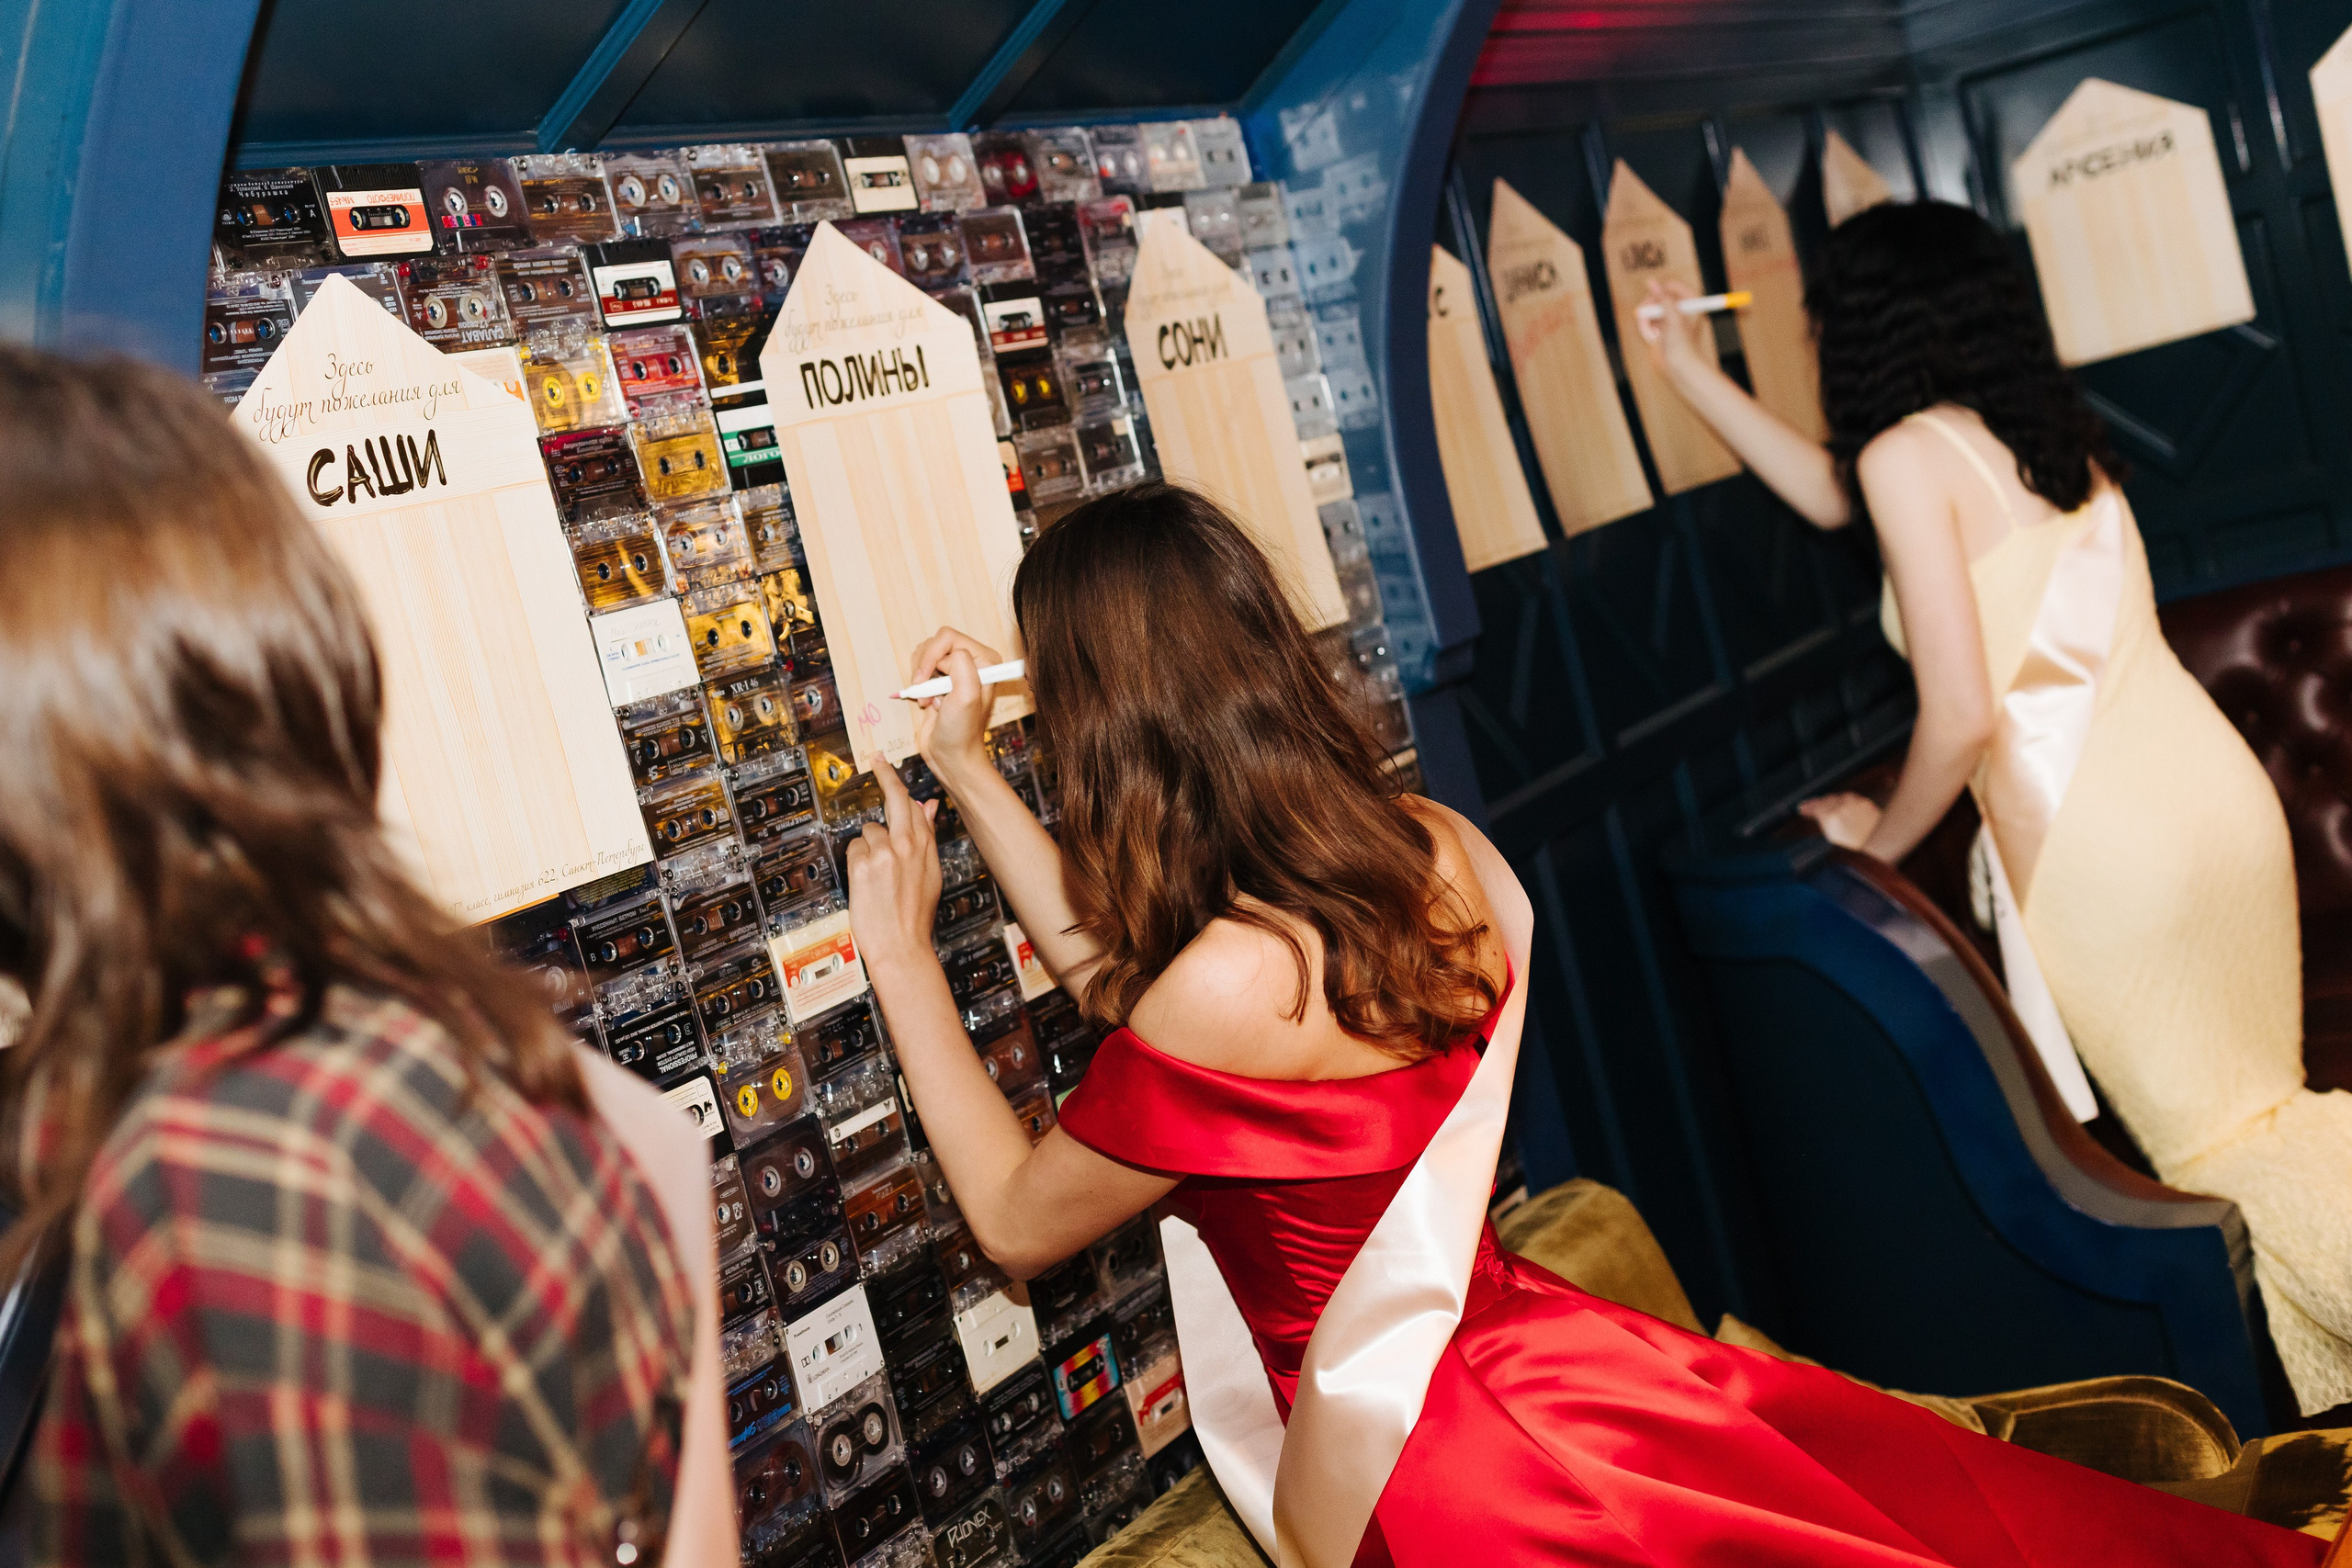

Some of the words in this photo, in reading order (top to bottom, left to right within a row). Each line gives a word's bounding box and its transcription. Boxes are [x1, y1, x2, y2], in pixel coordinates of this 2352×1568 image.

[239, 190, 289, 198] Чебурашка
[1158, 312, 1229, 371] СОНИ
[324, 353, 375, 400] Здесь
[799, 344, 930, 410] ПОЛИНЫ
[253, 387, 320, 444] будут
[321, 384, 424, 413] пожелания
[423, 378, 462, 421] для
[306, 428, 447, 506] САШИ
[742, 448, 782, 463] ЛОГО
[493, 881, 535, 904] гимназия
[561, 838, 645, 877] Санкт-Петербург
[660, 1051, 698, 1074] PROFESSIONAL
[812, 1366, 831, 1381] LONGMAN
